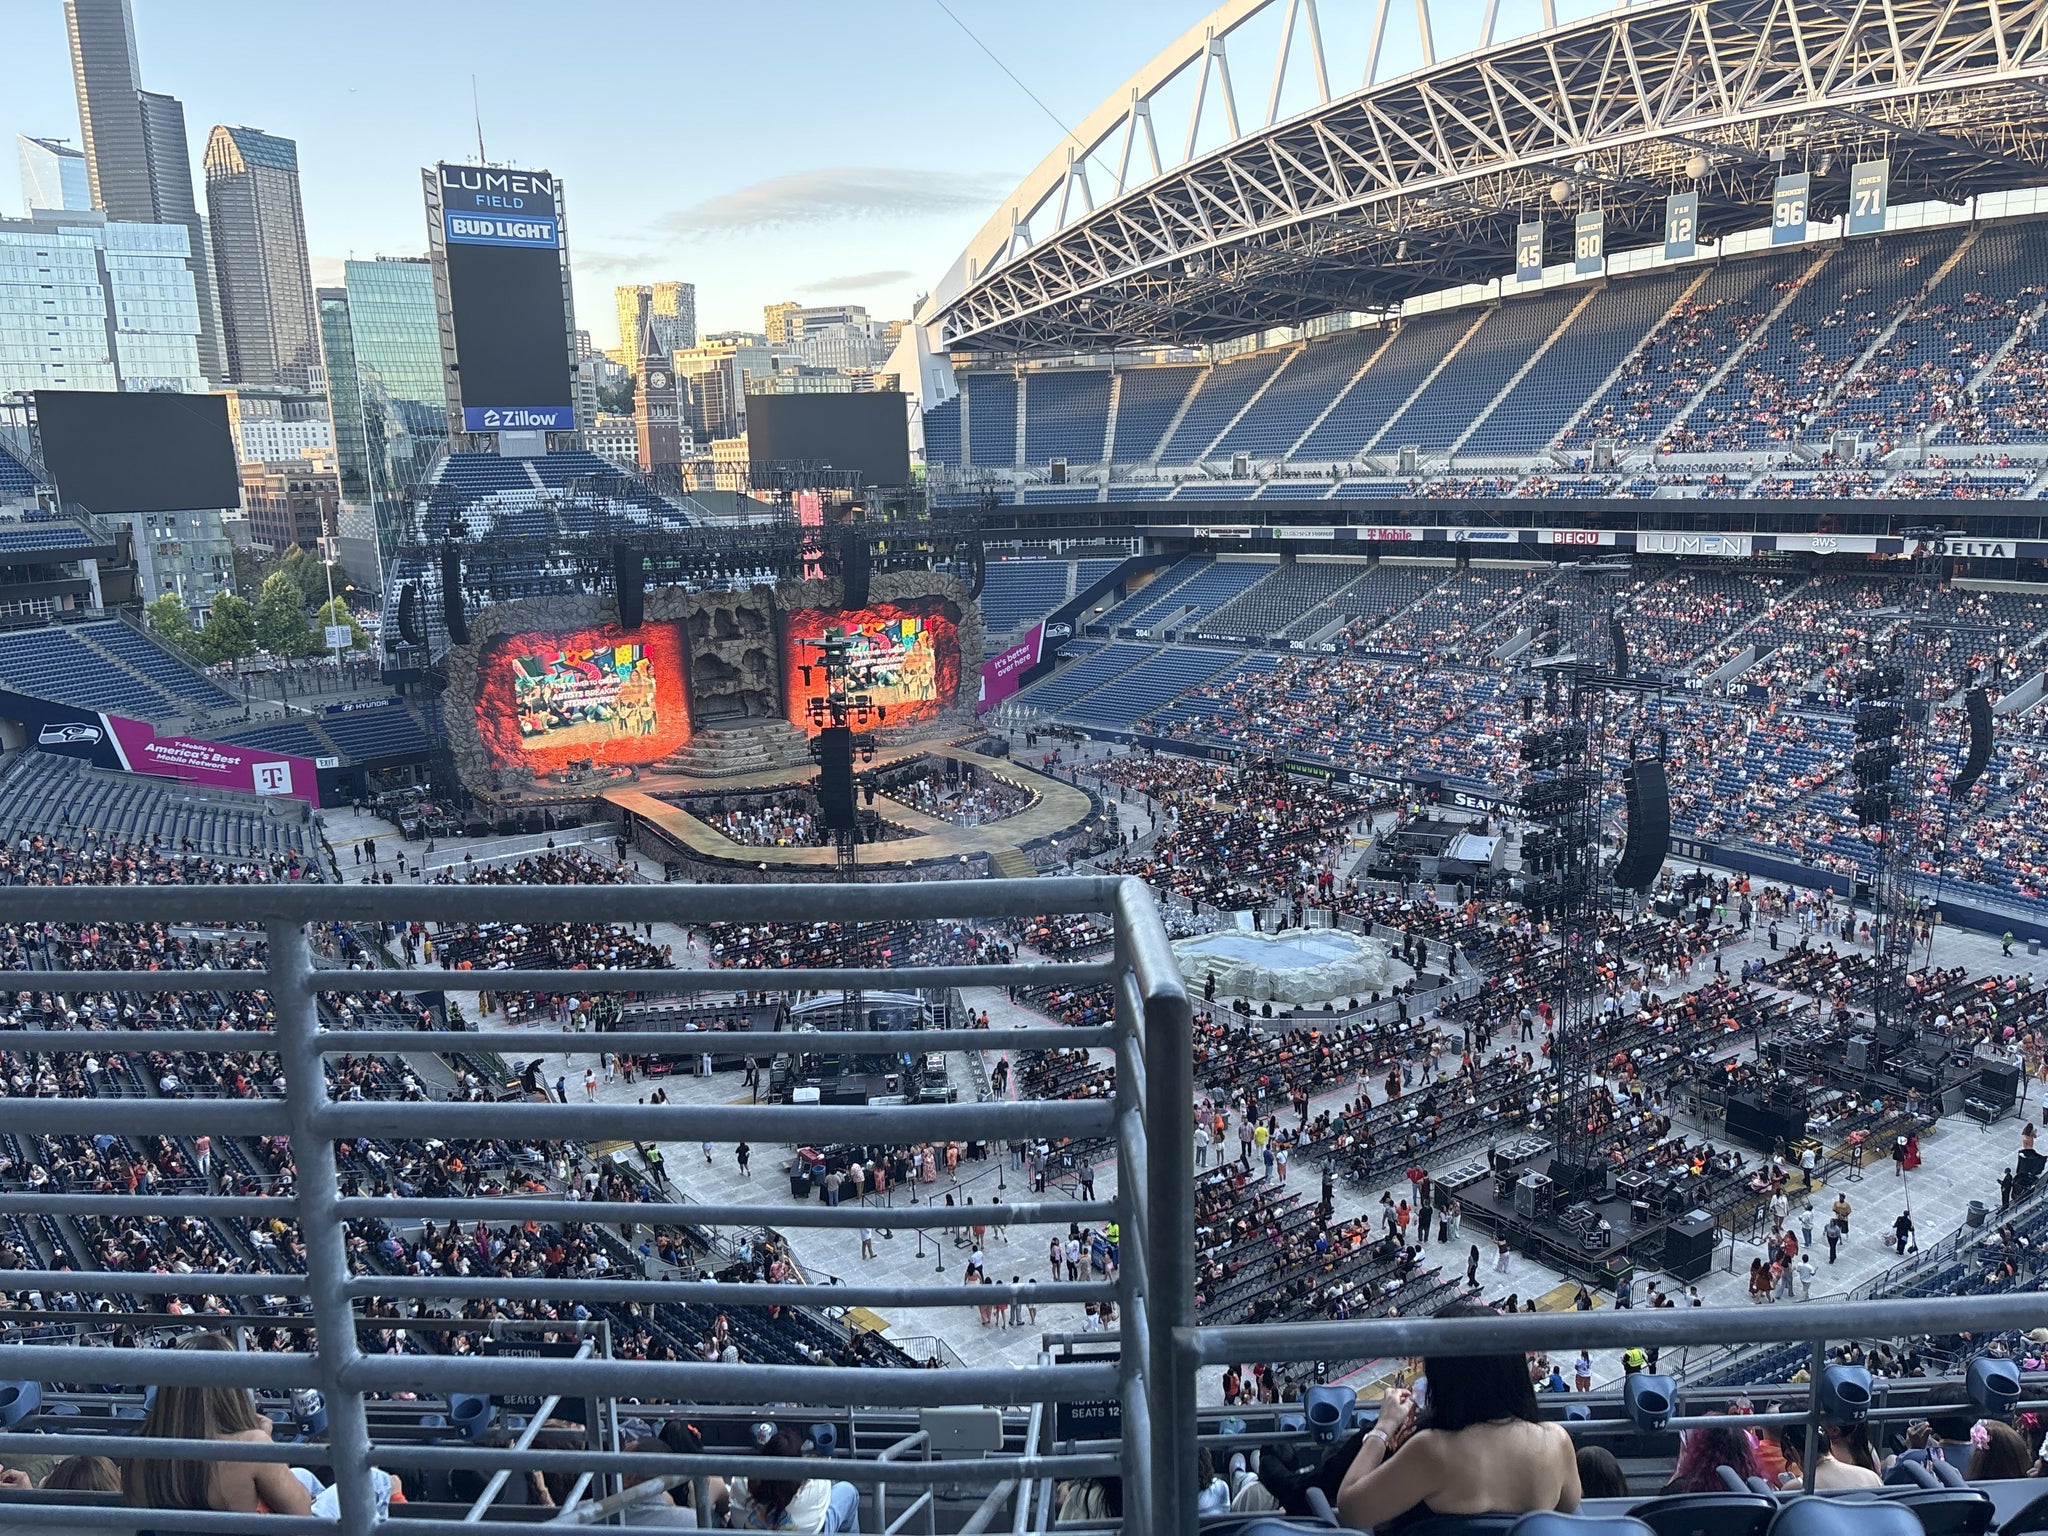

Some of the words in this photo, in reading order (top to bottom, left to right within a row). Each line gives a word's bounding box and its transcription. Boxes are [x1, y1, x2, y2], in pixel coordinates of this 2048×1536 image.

[442, 168, 552, 195] LUMEN
[1857, 175, 1882, 186] JONES
[475, 194, 524, 208] FIELD
[1855, 188, 1881, 217] 71
[1775, 200, 1805, 228] 96
[452, 218, 494, 236] BUD
[499, 220, 552, 240] LIGHT
[1669, 218, 1692, 244] 12
[1577, 235, 1601, 259] 80
[1518, 245, 1541, 268] 45
[502, 411, 556, 427] Zillow
[1379, 529, 1412, 540] Mobile
[1468, 532, 1510, 540] BOEING
[1553, 532, 1598, 544] BECU
[1643, 536, 1741, 554] LUMEN
[1812, 537, 1837, 547] aws
[1936, 541, 2005, 557] DELTA
[1136, 629, 1148, 637] 204
[1290, 641, 1303, 649] 206
[1322, 643, 1336, 652] 206
[994, 658, 1007, 670] It's
[1006, 643, 1030, 663] better
[997, 663, 1014, 677] over
[1014, 653, 1031, 667] here
[552, 691, 583, 701] ARTISTS
[585, 686, 623, 698] BREAKING
[355, 700, 389, 710] HYUNDAI
[174, 740, 208, 752] T-Mobile
[143, 742, 210, 760] America's
[211, 752, 242, 766] Best
[155, 753, 187, 764] Mobile
[188, 758, 228, 770] Network
[319, 759, 335, 767] EXIT
[1063, 1156, 1072, 1166] N
[498, 1349, 541, 1358] SECTION
[1317, 1361, 1326, 1374] S
[503, 1395, 536, 1405] SEATS
[1071, 1408, 1105, 1419] SEATS
[1852, 1410, 1866, 1420] 13
[1652, 1419, 1667, 1429] 14
